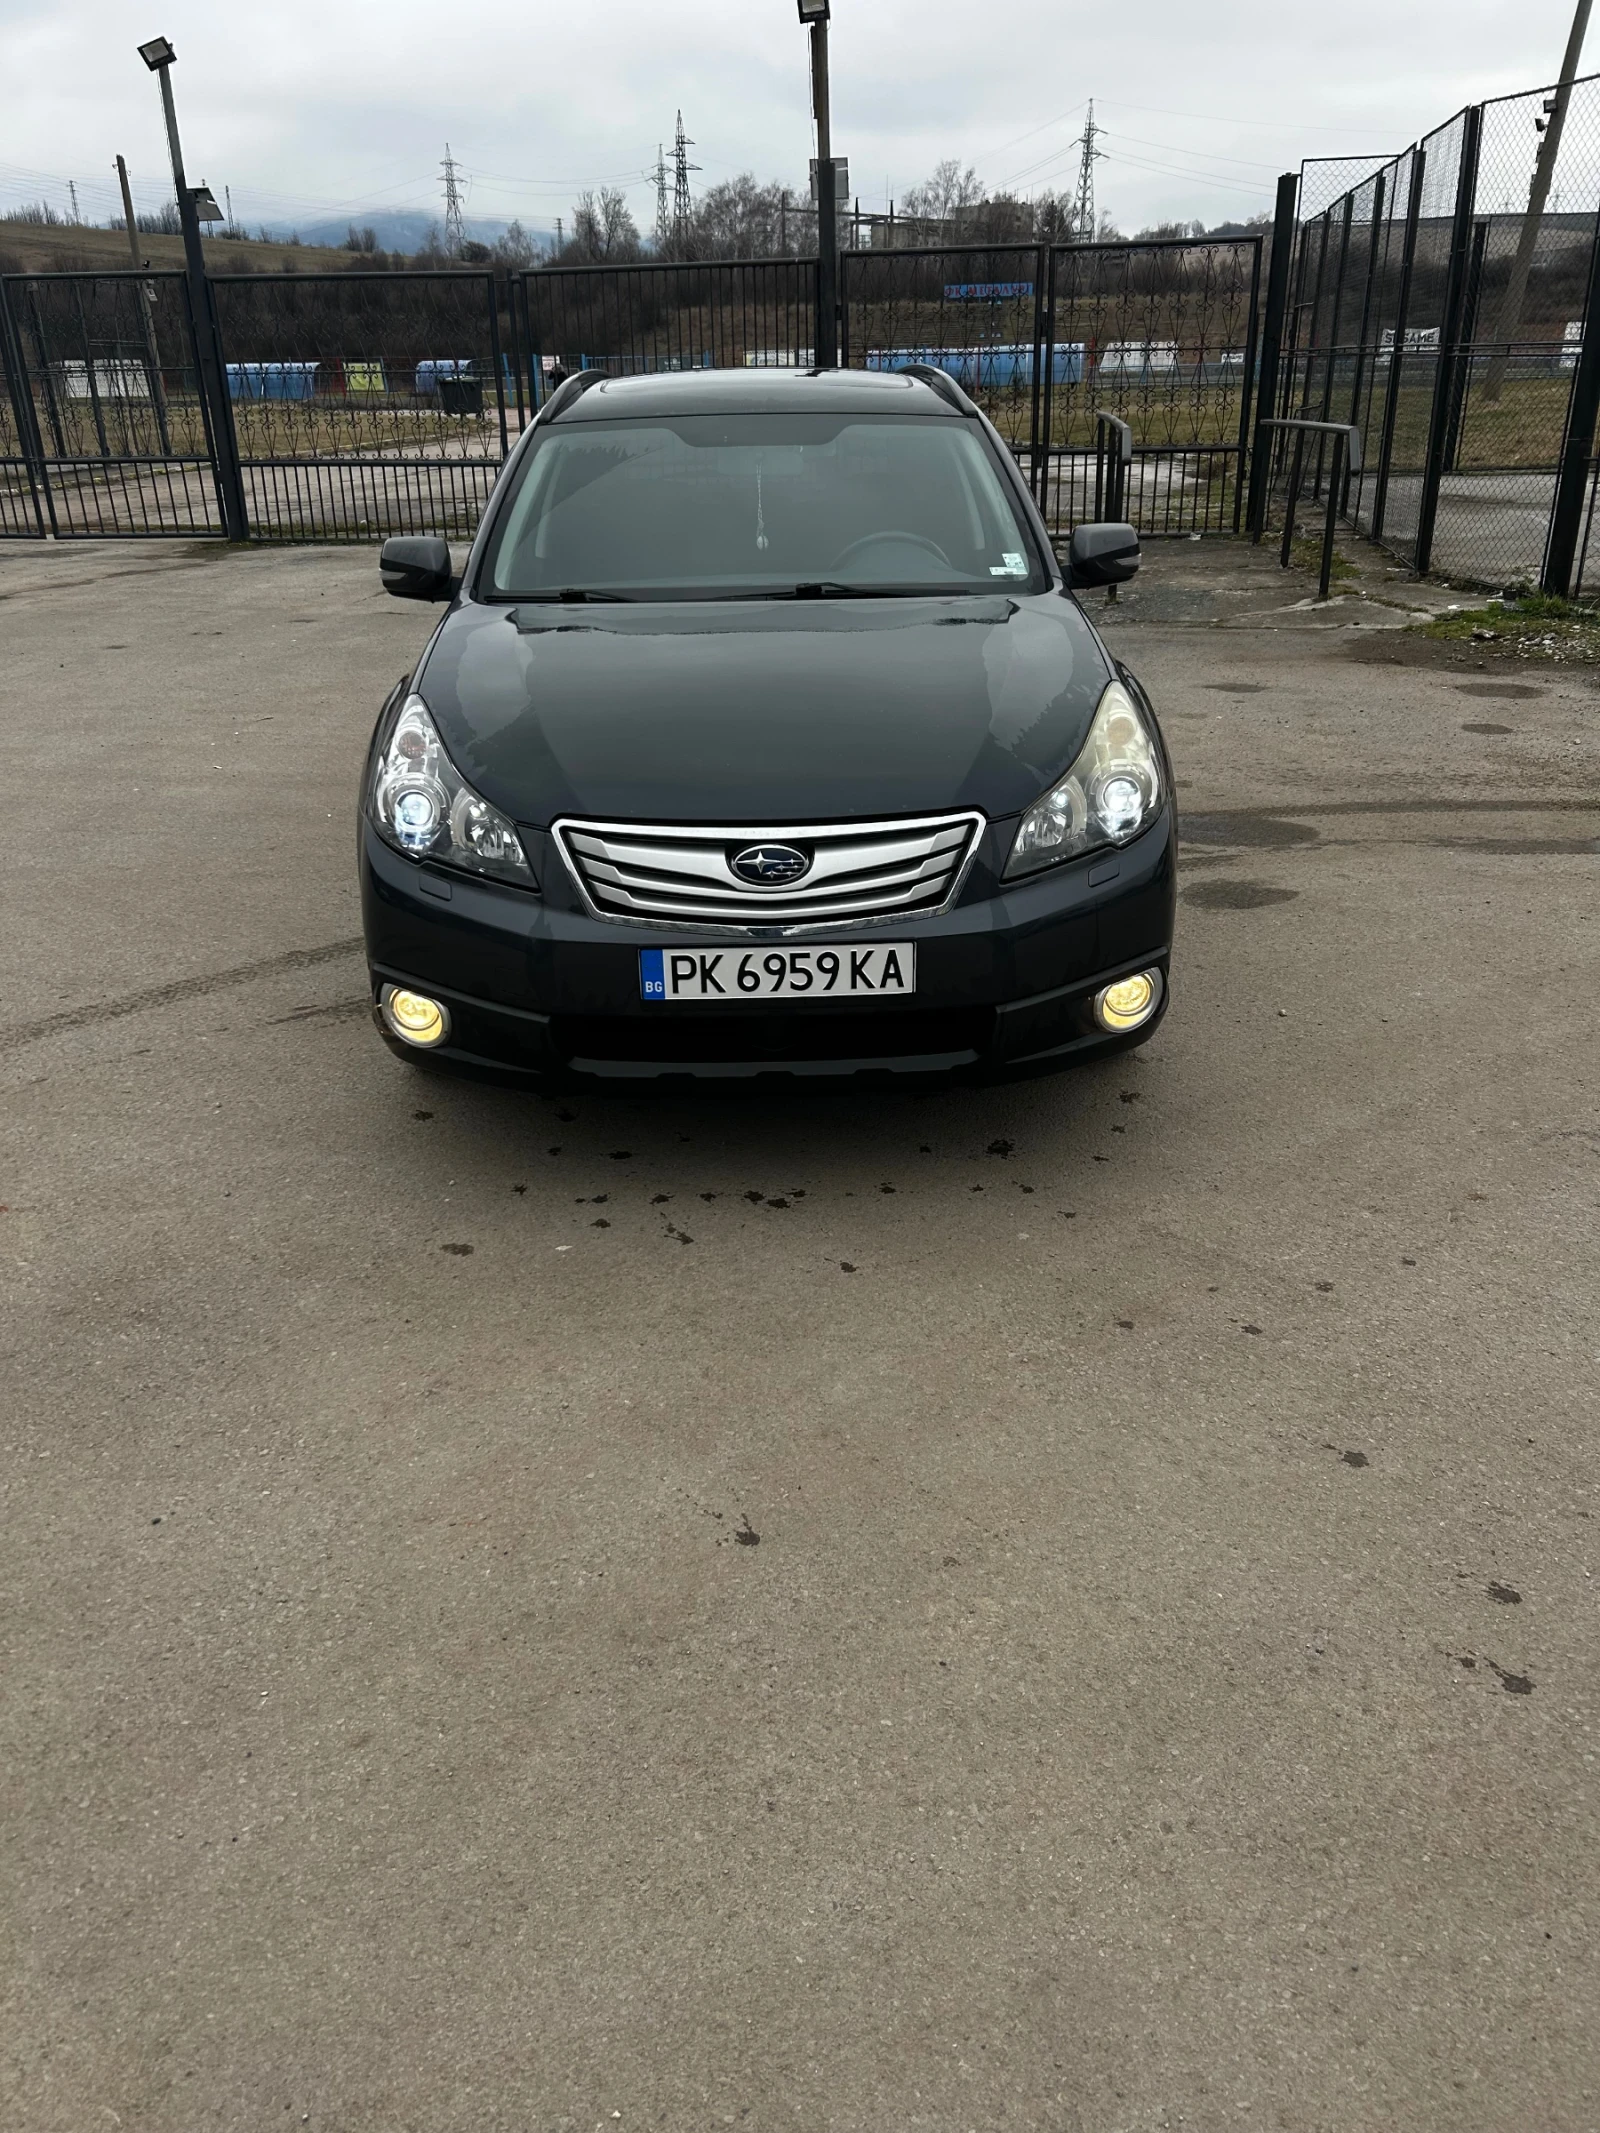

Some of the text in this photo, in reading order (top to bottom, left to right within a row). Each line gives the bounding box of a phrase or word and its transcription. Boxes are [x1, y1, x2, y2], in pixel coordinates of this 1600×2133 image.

[1384, 331, 1435, 344] SSAME
[670, 949, 905, 994] PK 6959 KA
[645, 981, 663, 993] BG
